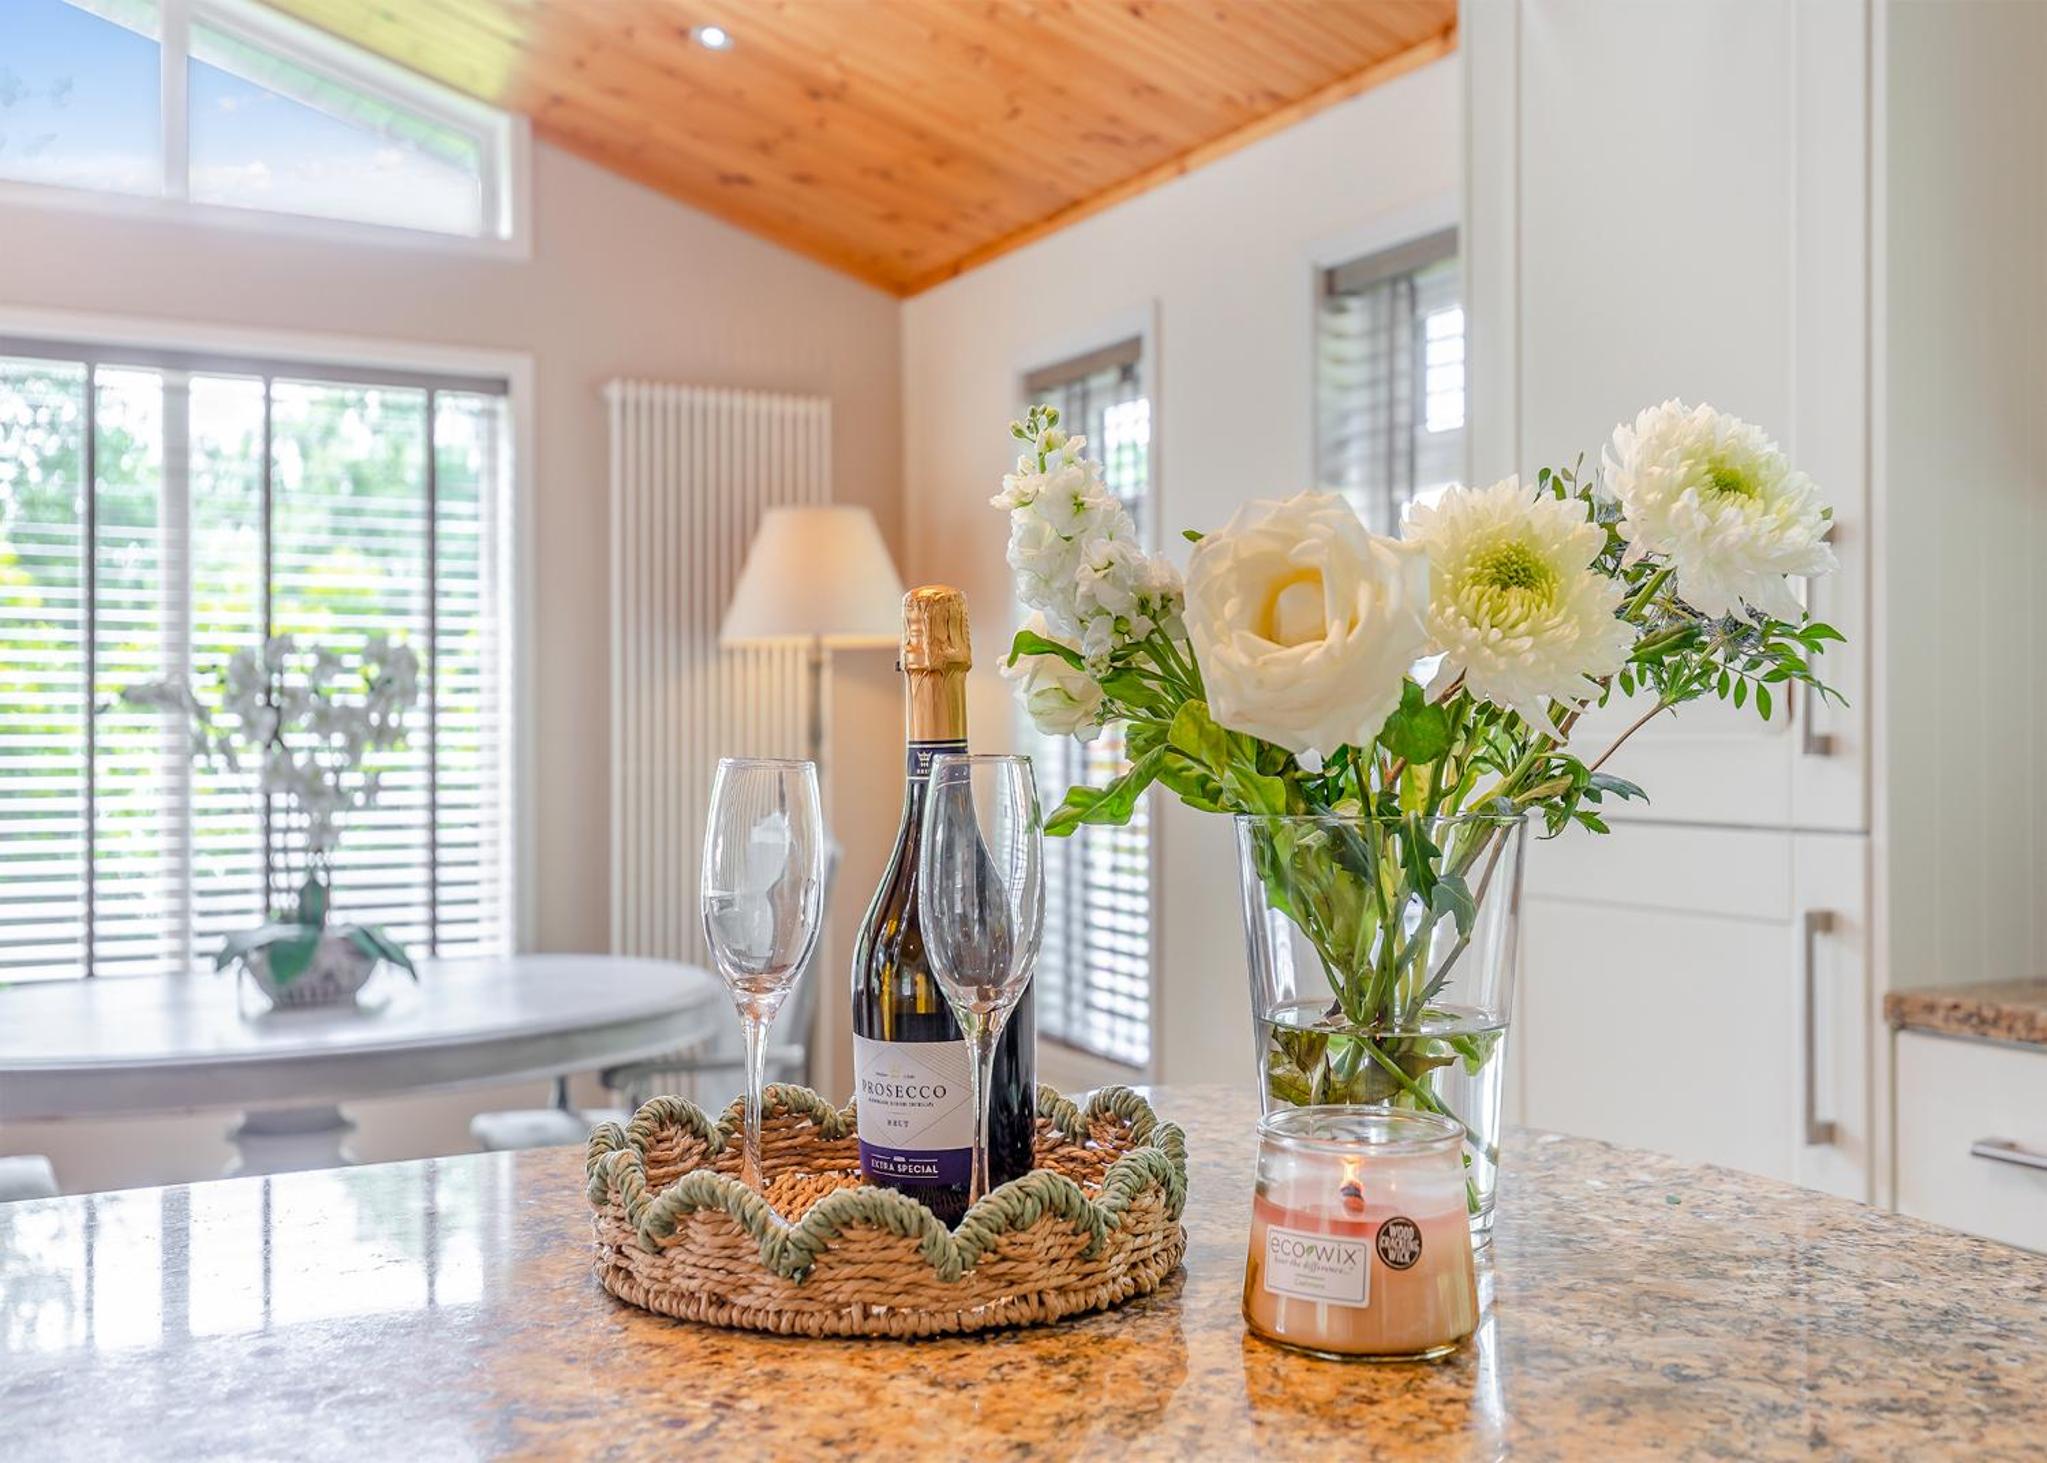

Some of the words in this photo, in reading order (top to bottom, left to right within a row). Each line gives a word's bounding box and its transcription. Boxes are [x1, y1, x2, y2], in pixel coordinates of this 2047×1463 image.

[862, 1079, 947, 1100] PROSECCO
[871, 1158, 895, 1172] EXTRA
[897, 1163, 939, 1174] SPECIAL
[1388, 1224, 1415, 1241] WOOD
[1388, 1249, 1411, 1263] WICK
